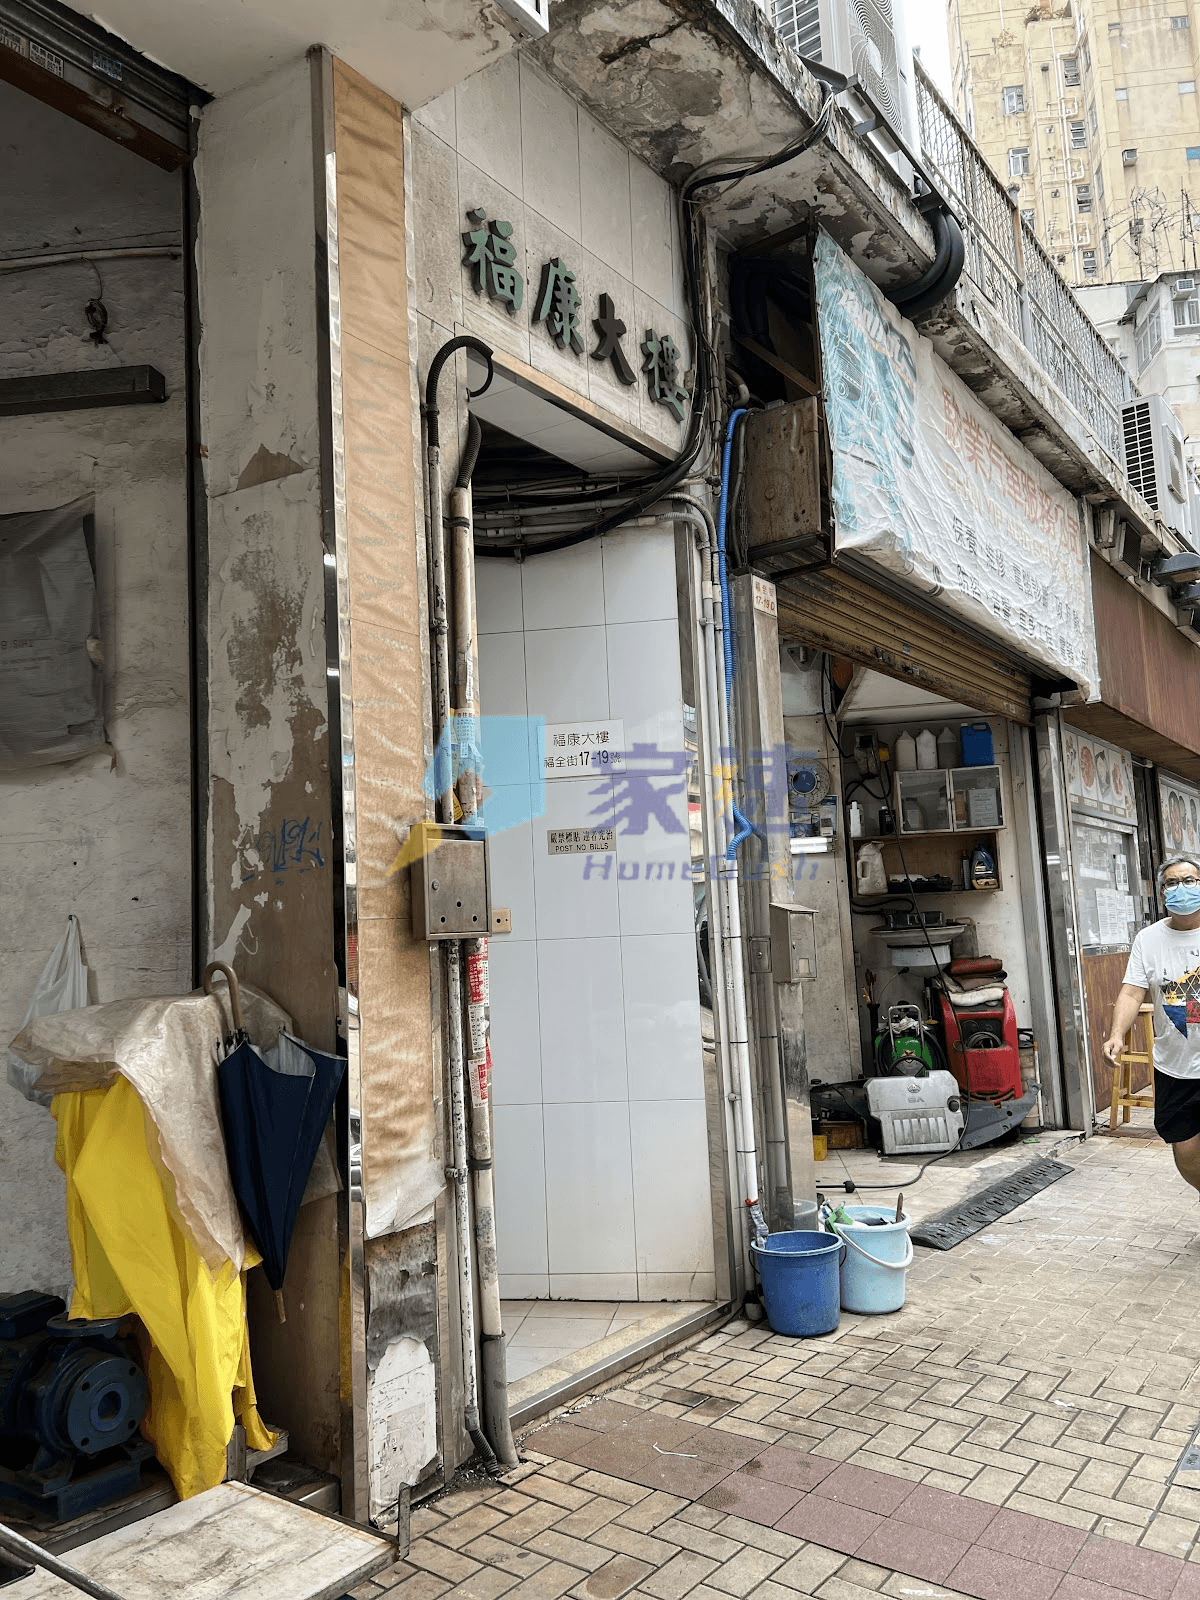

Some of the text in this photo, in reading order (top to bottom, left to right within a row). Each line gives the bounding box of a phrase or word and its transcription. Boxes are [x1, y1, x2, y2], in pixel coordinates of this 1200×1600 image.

[462, 208, 690, 422] 福康大樓
[553, 731, 610, 747] 福康大樓
[589, 842, 609, 850] BILLS
